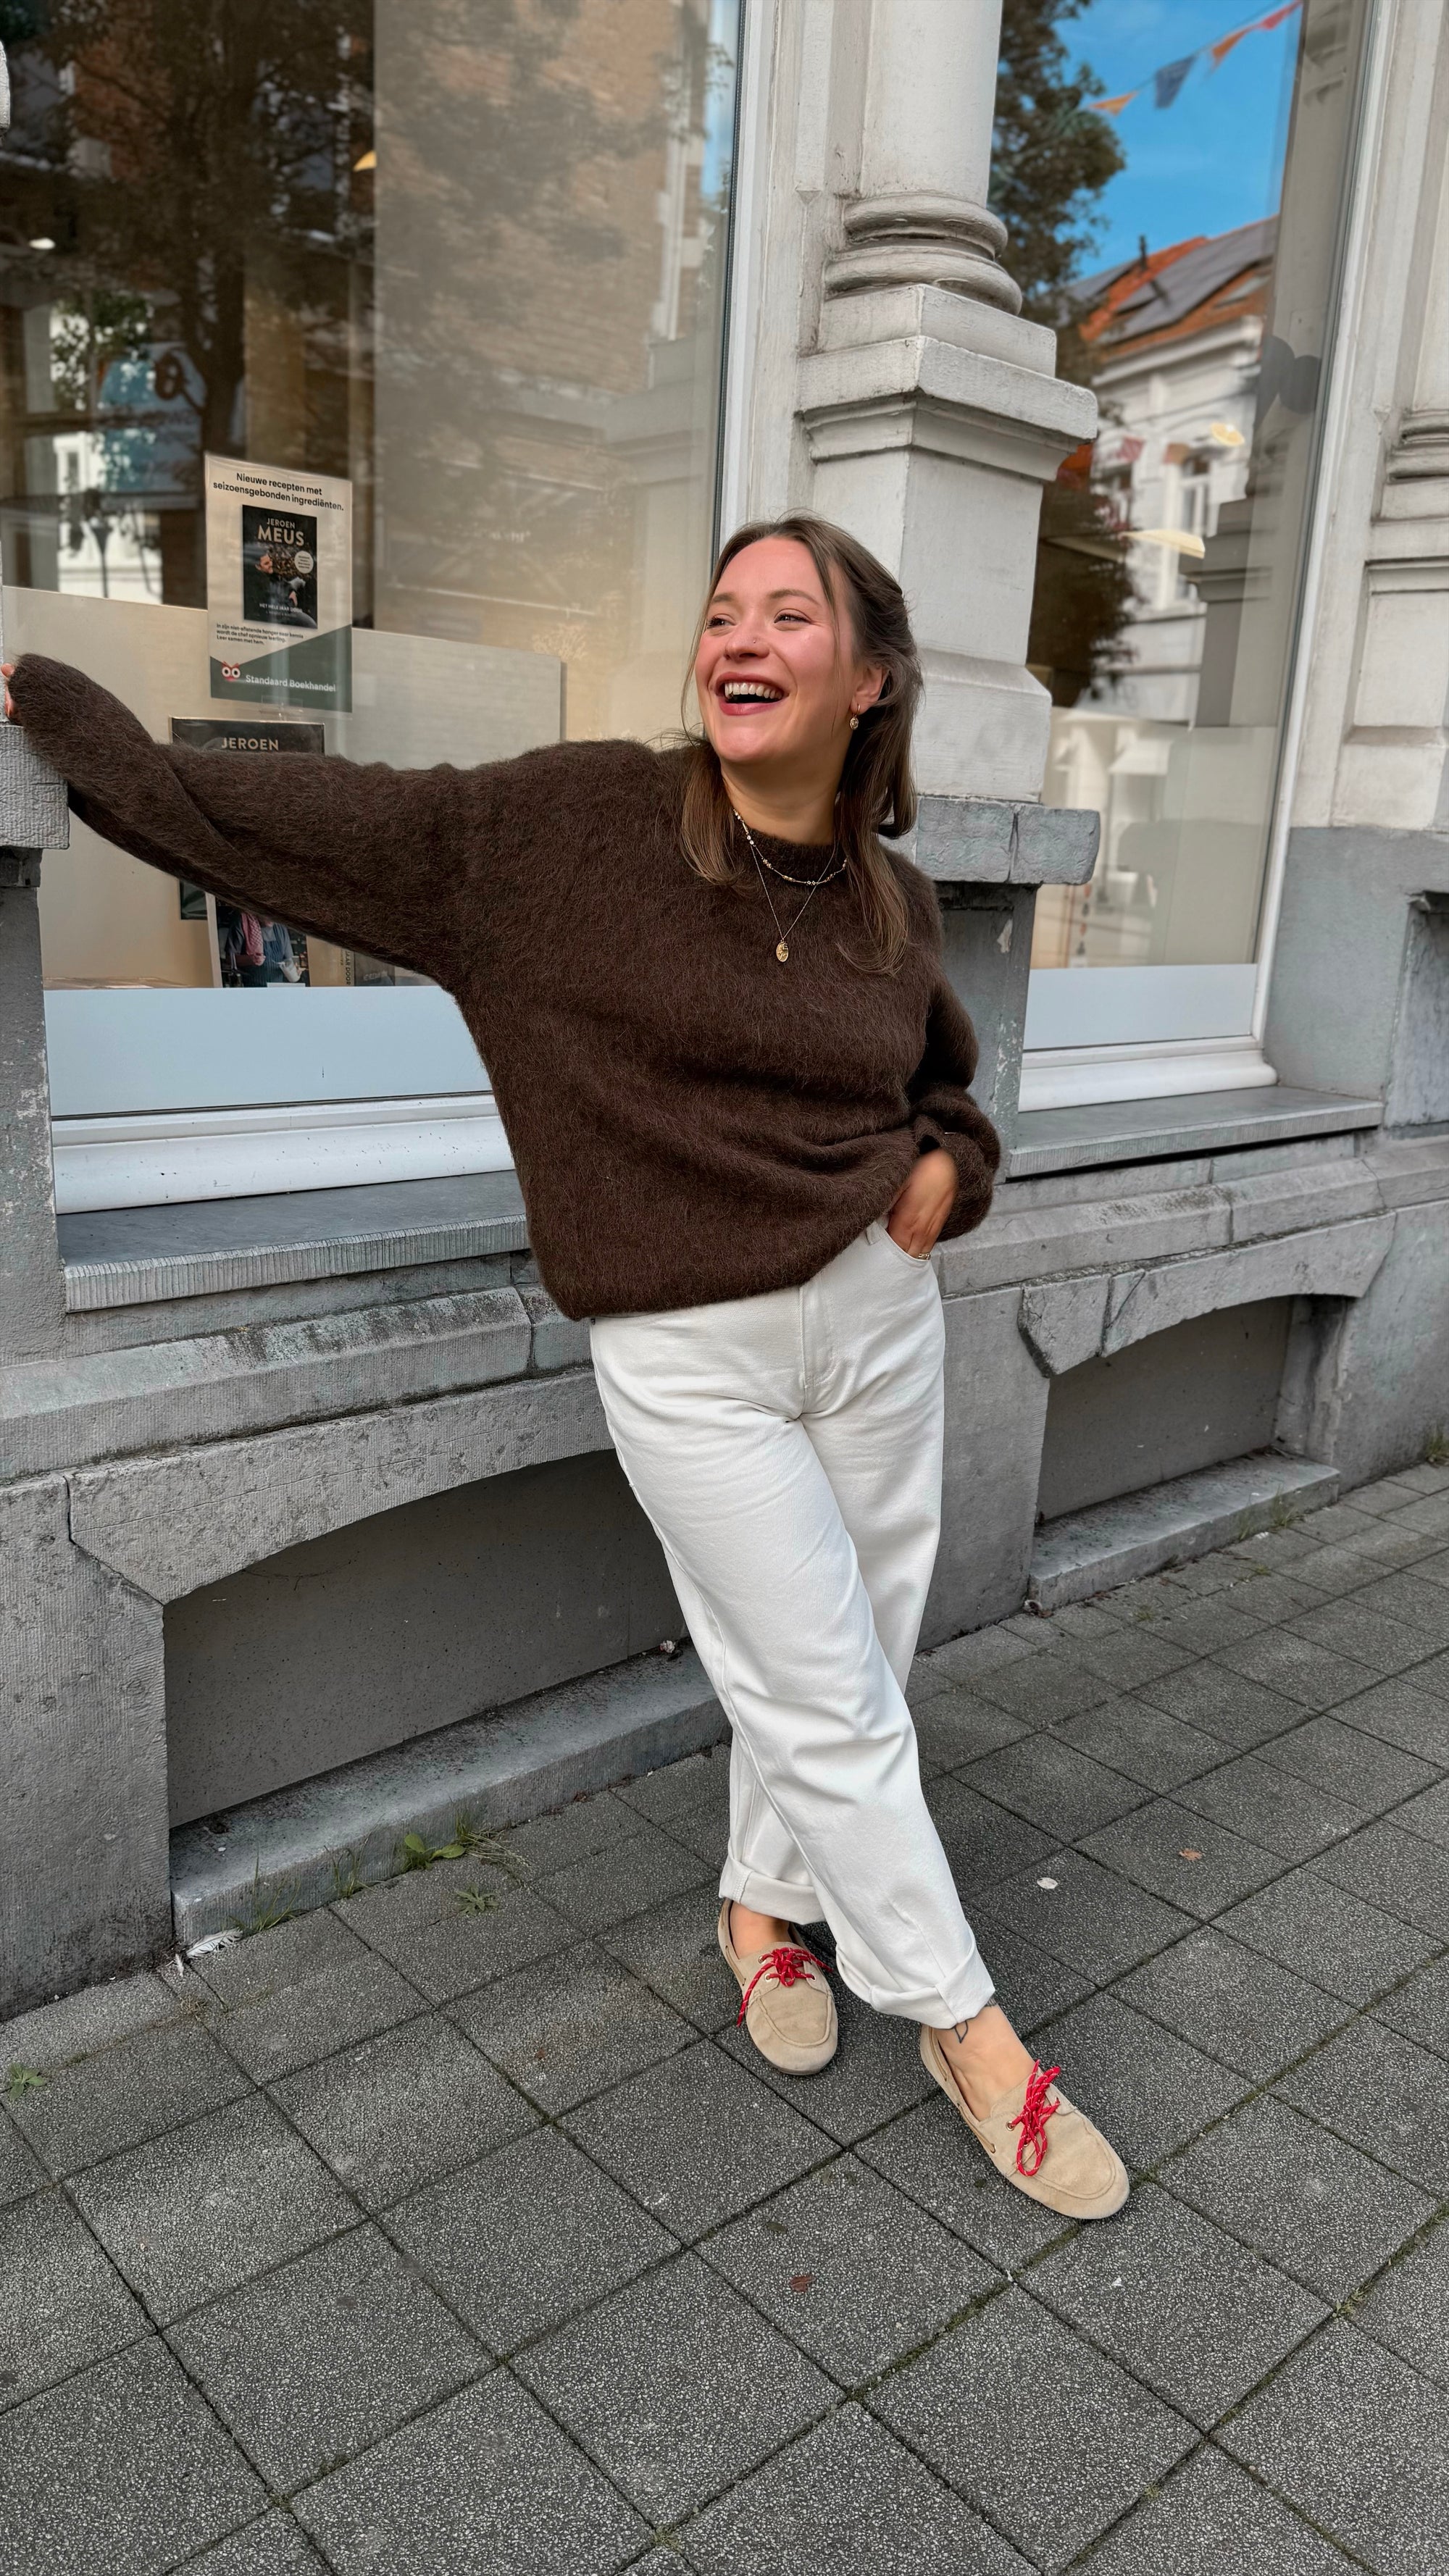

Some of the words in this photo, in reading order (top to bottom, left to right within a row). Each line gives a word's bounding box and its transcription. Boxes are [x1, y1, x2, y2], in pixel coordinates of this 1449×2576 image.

[237, 472, 267, 485] Nieuwe
[269, 480, 305, 492] recepten
[306, 487, 322, 495] met
[213, 482, 291, 501] seizoensgebonden
[292, 494, 344, 511] ingrediënten.
[267, 518, 296, 529] JEROEN
[257, 526, 304, 546] MEUS
[246, 674, 288, 687] Standaard
[290, 681, 337, 693] Boekhandel
[221, 737, 279, 751] JEROEN
